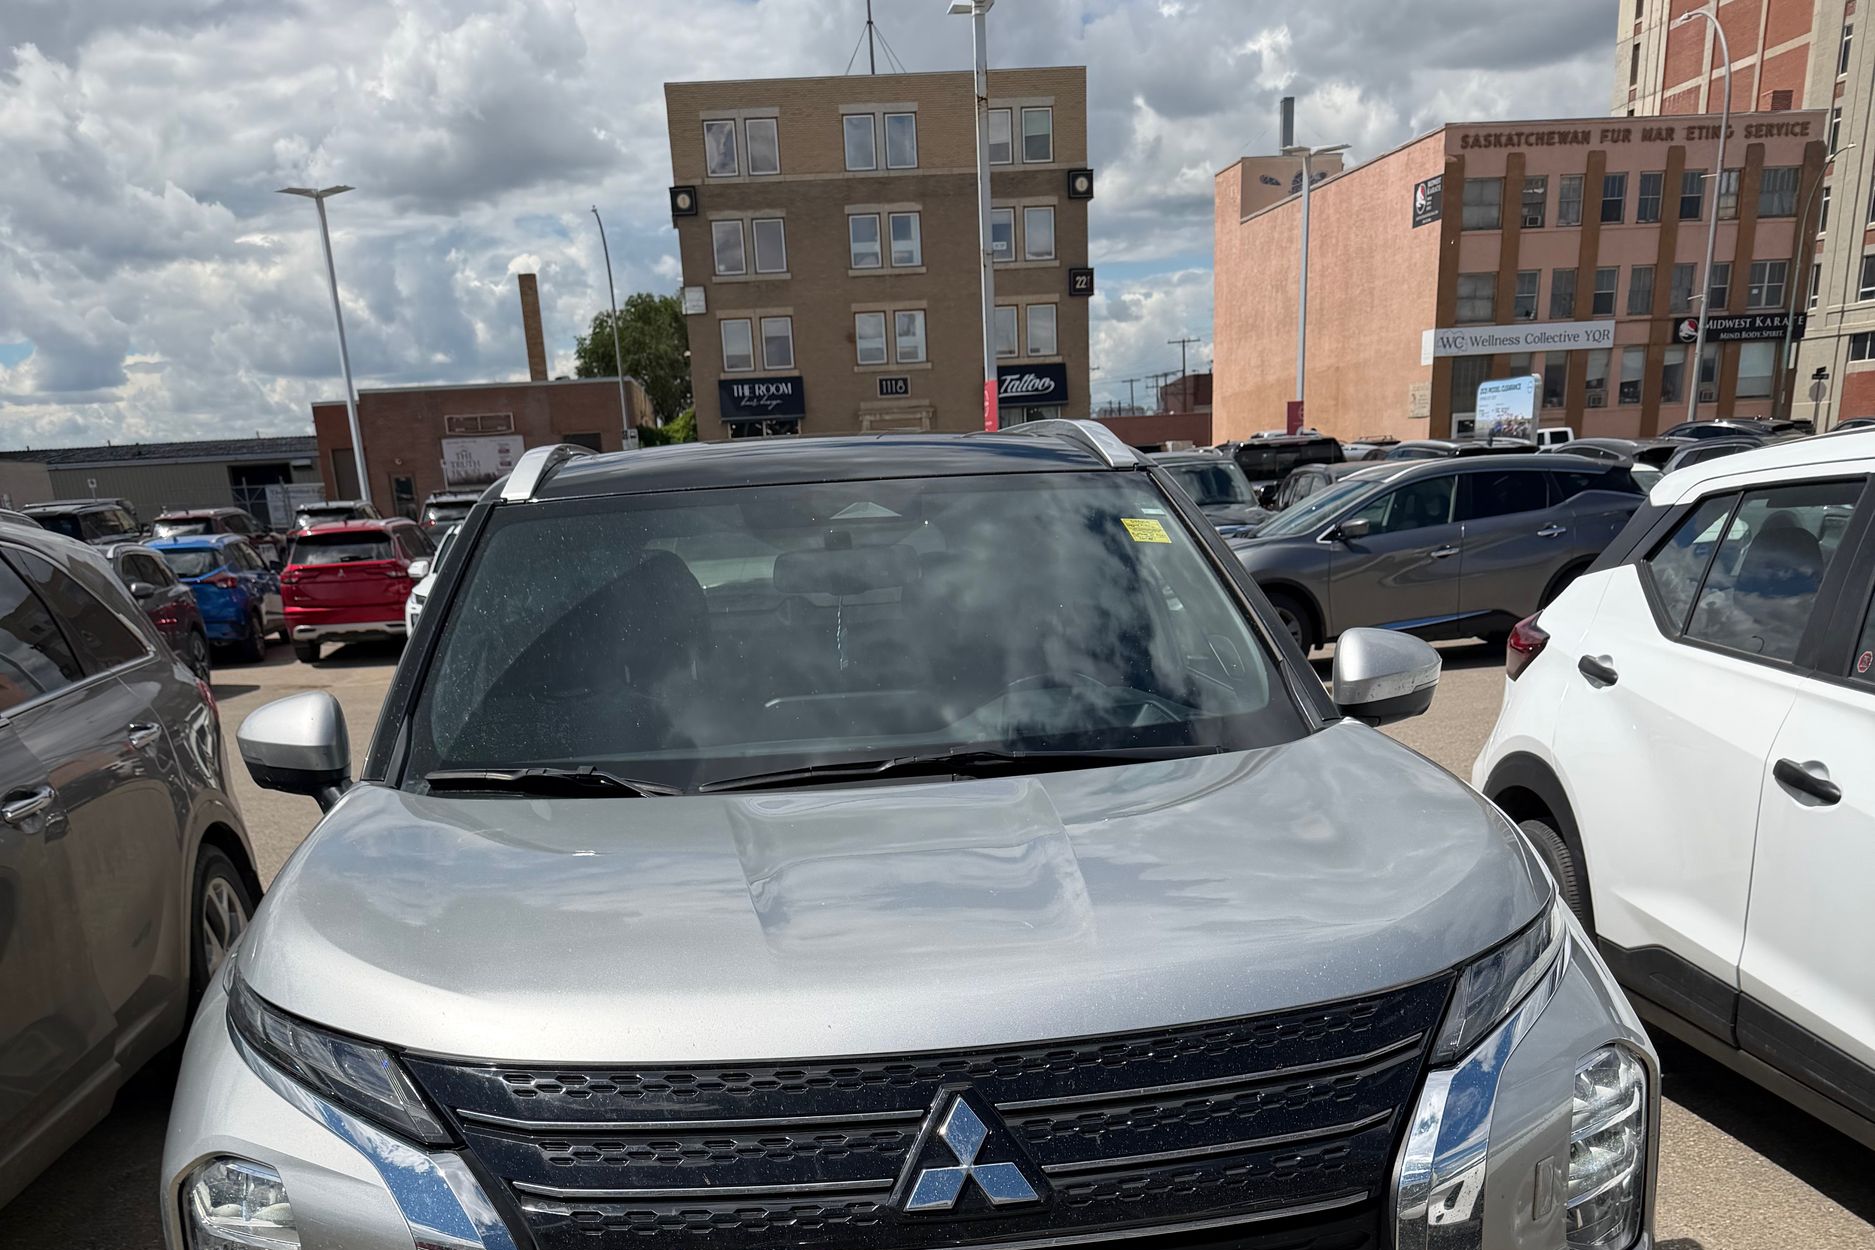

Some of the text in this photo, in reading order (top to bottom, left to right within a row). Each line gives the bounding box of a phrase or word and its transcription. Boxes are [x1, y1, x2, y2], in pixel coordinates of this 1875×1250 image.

[1460, 129, 1592, 149] SASKATCHEWAN
[1600, 128, 1633, 144] FUR
[1743, 121, 1811, 139] SERVICE
[1705, 318, 1752, 330] MIDWEST
[1440, 329, 1611, 350] WC Wellness Collective YQR
[732, 382, 792, 397] THE ROOM
[881, 380, 905, 393] 1118
[998, 373, 1055, 398] Tattoo
